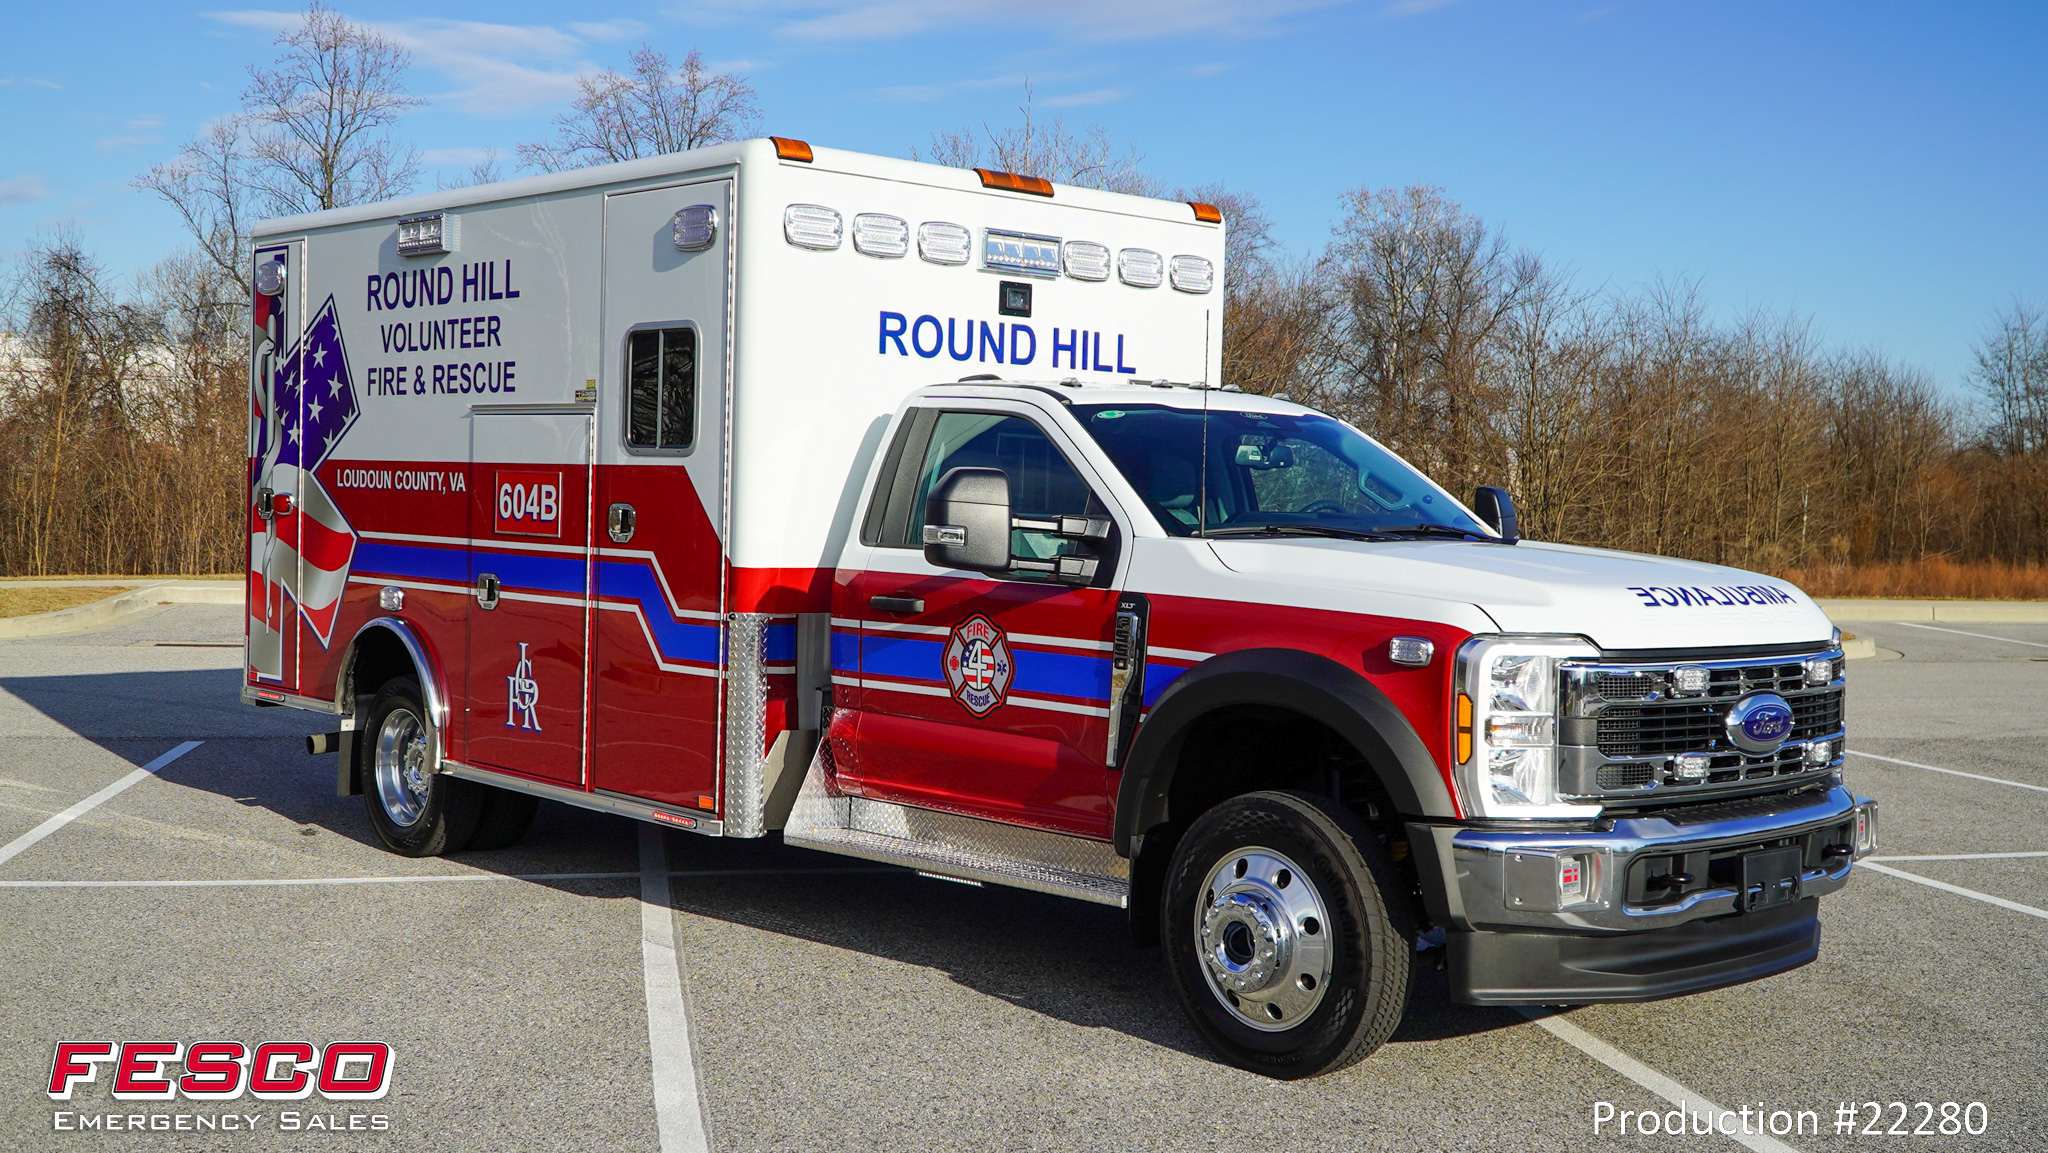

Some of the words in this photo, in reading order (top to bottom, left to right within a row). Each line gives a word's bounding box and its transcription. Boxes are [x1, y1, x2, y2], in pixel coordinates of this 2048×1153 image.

[367, 266, 453, 312] ROUND
[462, 259, 520, 302] HILL
[381, 315, 501, 353] VOLUNTEER
[879, 310, 1037, 366] ROUND
[1052, 327, 1137, 374] HILL
[367, 366, 407, 396] FIRE
[413, 365, 426, 395] &
[433, 361, 516, 395] RESCUE
[336, 469, 392, 489] LOUDOUN
[394, 471, 446, 495] COUNTY,
[449, 472, 466, 492] VA
[499, 482, 558, 521] 604B
[966, 622, 990, 640] FIRE
[968, 640, 988, 690] 4
[966, 690, 991, 708] RESCUE
[1753, 711, 1785, 735] Ford
